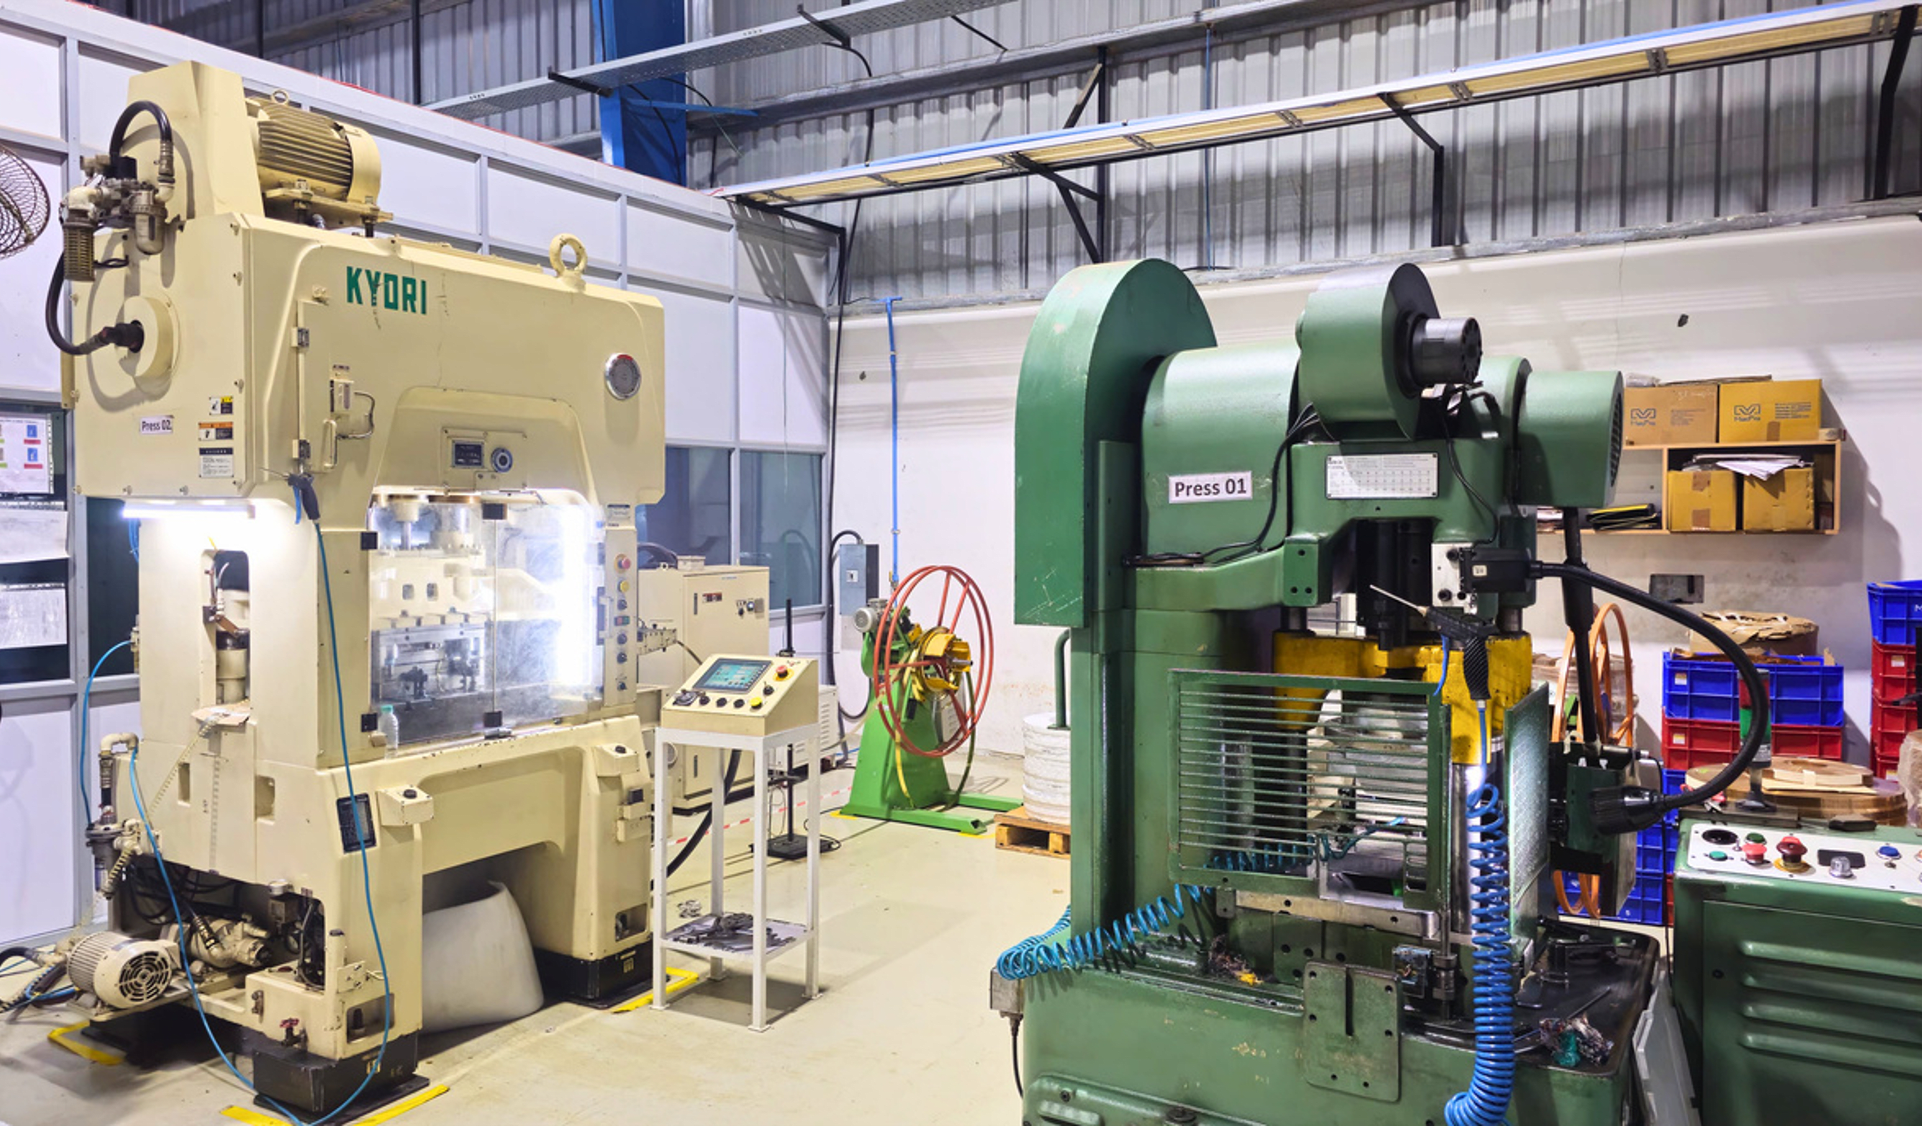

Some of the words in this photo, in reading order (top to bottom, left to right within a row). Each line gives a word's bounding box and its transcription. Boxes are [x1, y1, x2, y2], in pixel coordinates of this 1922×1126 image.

[346, 266, 426, 315] KYORI
[142, 421, 161, 432] Press
[161, 420, 172, 431] 02
[1175, 481, 1220, 497] Press
[1225, 478, 1247, 495] 01
